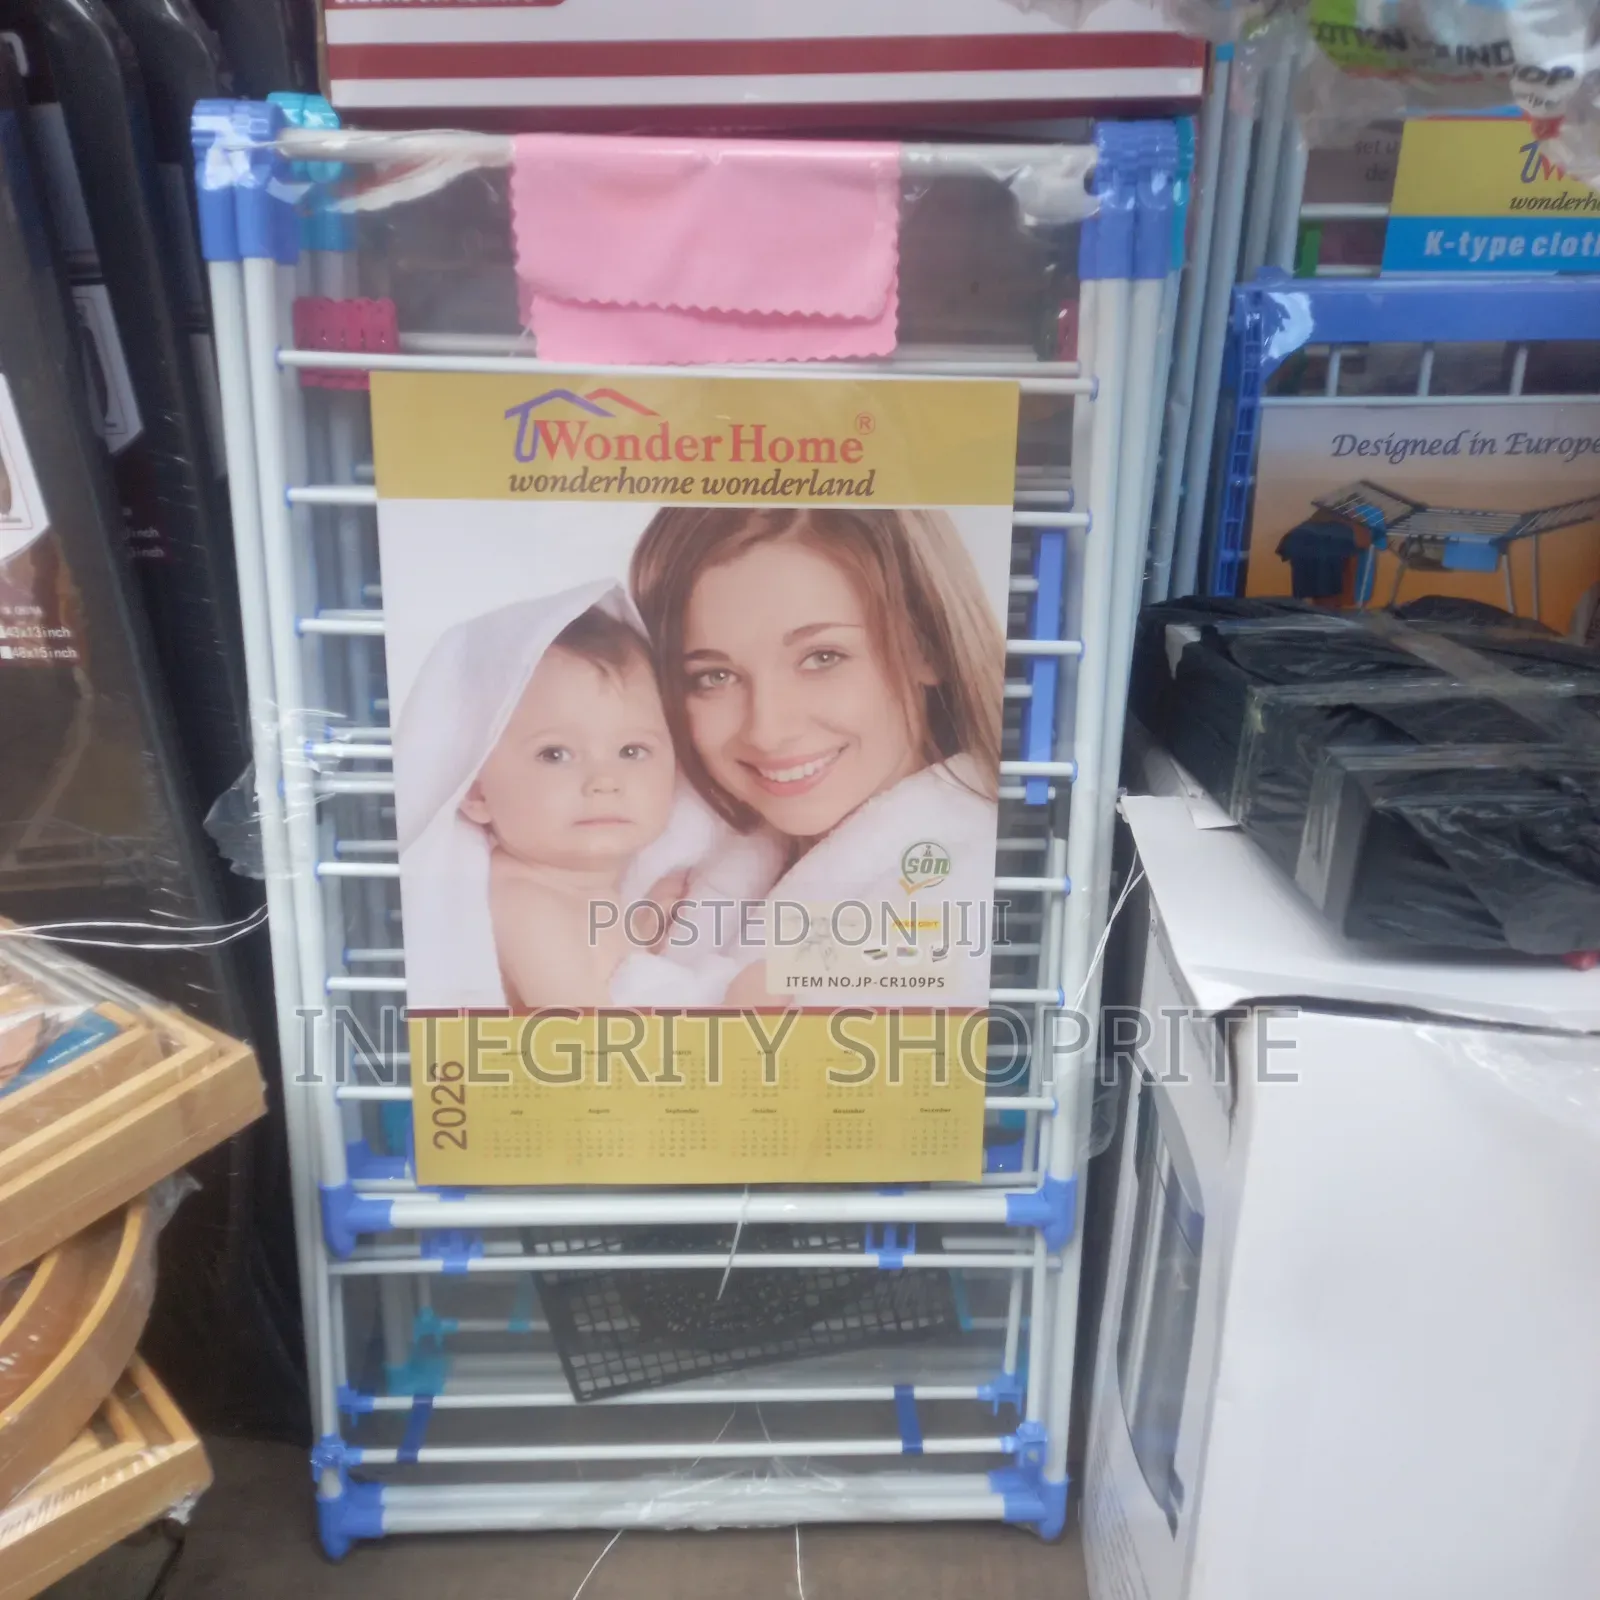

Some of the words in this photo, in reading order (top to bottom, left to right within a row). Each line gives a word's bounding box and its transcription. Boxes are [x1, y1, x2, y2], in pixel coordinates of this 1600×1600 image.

[1423, 231, 1526, 263] K-type
[1331, 429, 1471, 465] Designed
[1470, 431, 1498, 456] in
[508, 465, 695, 496] wonderhome
[701, 468, 876, 497] wonderland
[786, 976, 823, 988] ITEM
[430, 1060, 468, 1151] 2026
